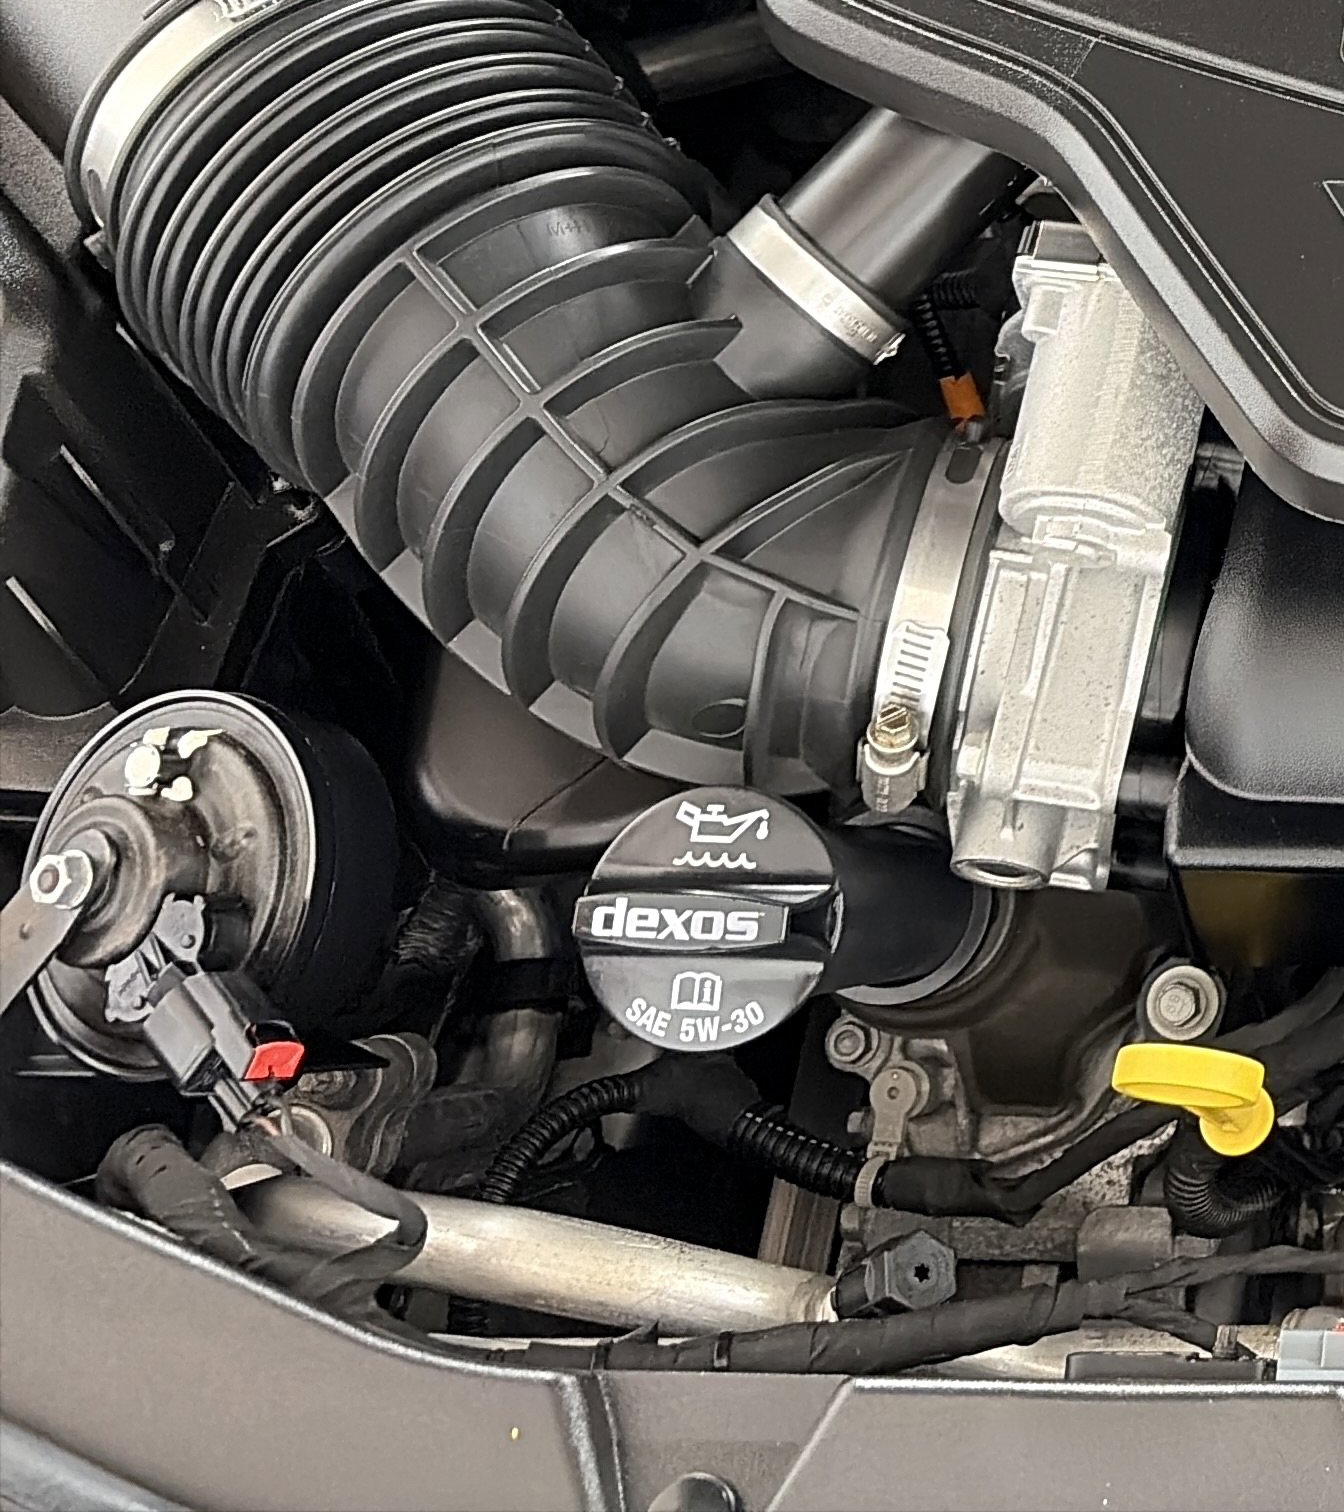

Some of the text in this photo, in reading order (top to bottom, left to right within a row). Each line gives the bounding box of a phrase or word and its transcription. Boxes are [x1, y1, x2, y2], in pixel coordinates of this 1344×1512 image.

[590, 897, 760, 941] dexos
[625, 997, 765, 1043] SAE 5W-30
